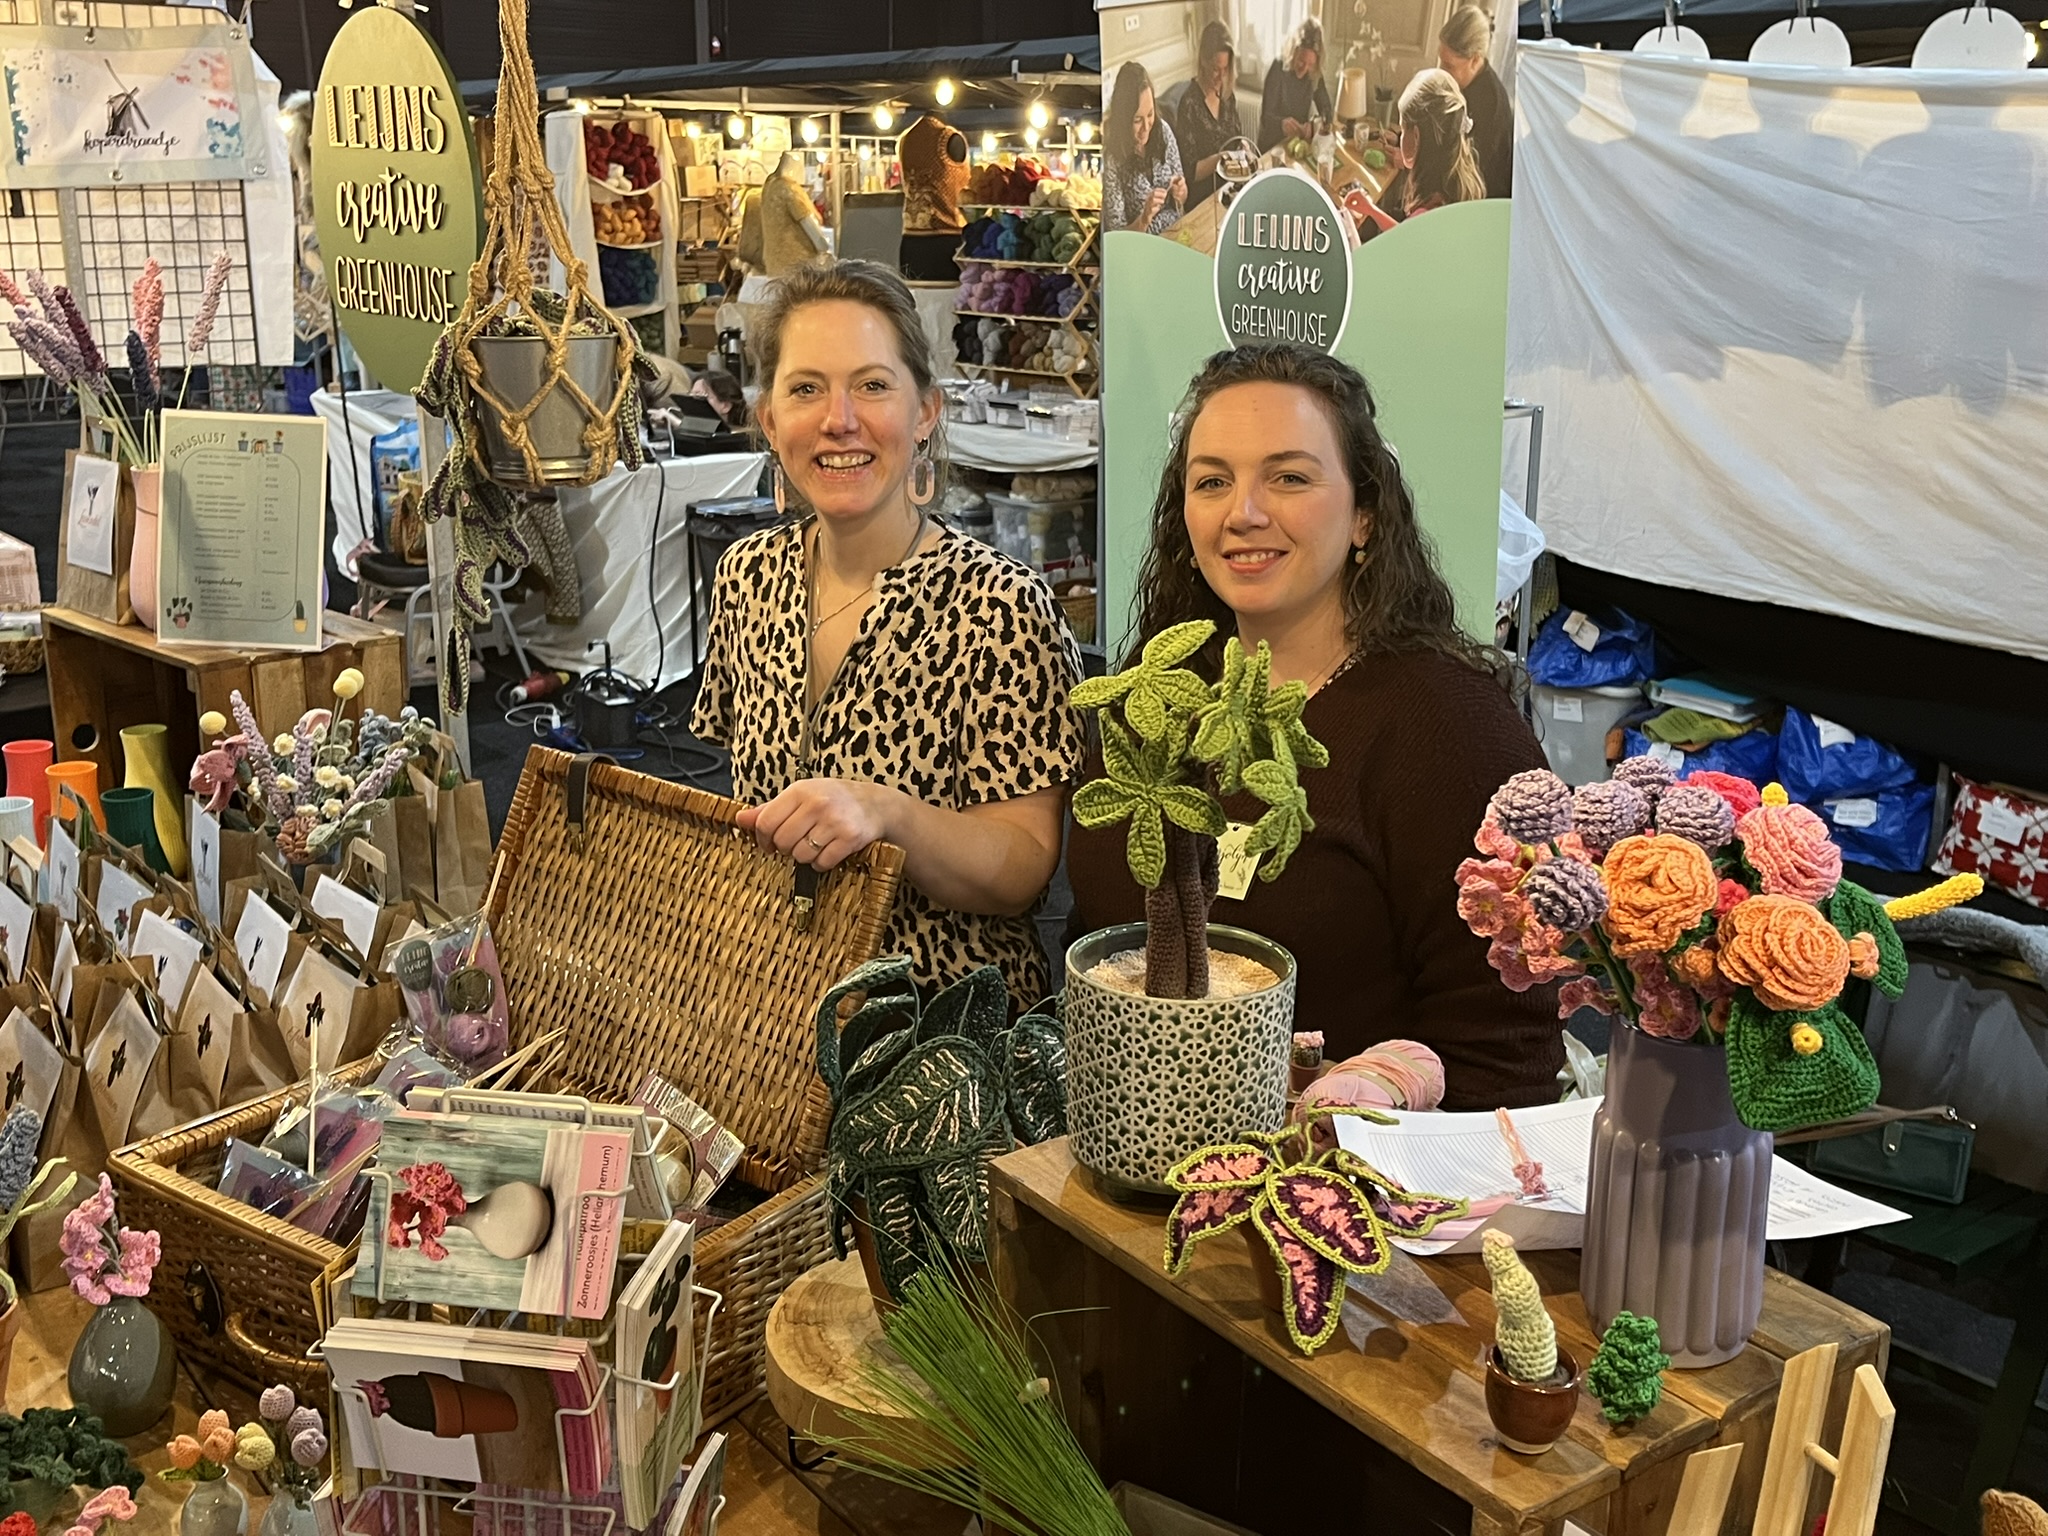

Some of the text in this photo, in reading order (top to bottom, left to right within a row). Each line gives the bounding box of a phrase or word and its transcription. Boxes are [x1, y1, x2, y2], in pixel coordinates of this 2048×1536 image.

[325, 84, 446, 155] LEIJNS
[335, 166, 445, 244] creative
[1236, 211, 1331, 255] LEIJNS
[334, 254, 456, 326] GREENHOUSE
[1237, 256, 1325, 299] creative
[1230, 302, 1328, 348] GREENHOUSE
[169, 431, 227, 460] PRIJSLIJST
[589, 1144, 614, 1232] (Helianhemum)
[576, 1234, 599, 1310] Zonneroosjes
